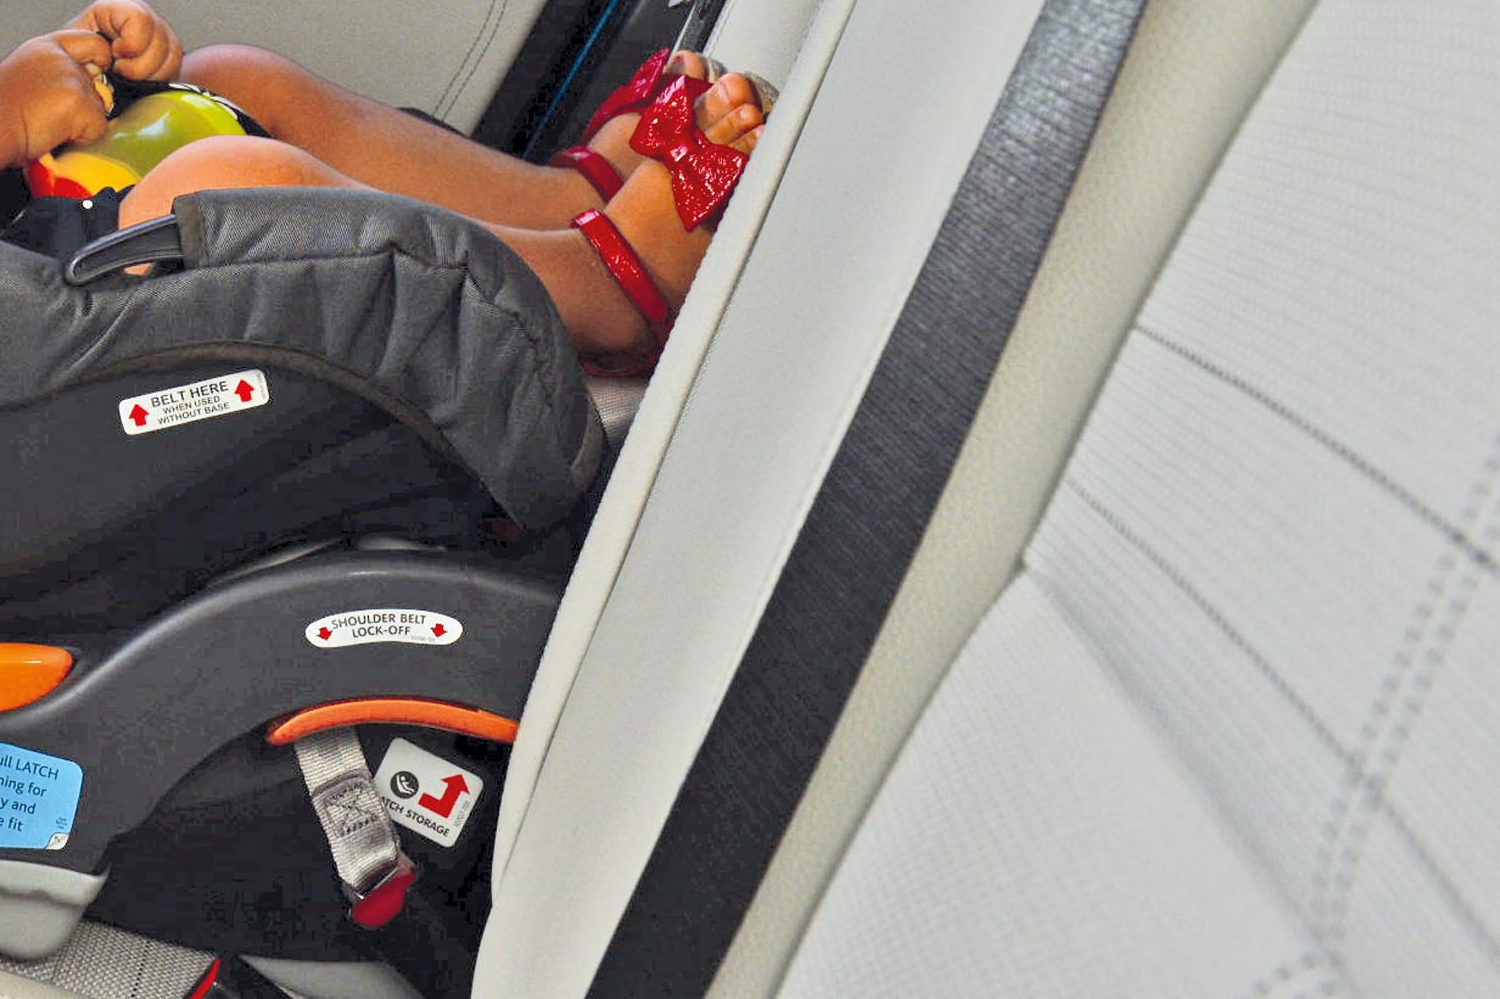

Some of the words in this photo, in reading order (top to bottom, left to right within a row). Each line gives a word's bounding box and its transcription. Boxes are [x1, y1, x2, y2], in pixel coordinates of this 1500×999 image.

[151, 390, 187, 408] BELT
[190, 381, 229, 399] HERE
[158, 410, 202, 425] WITHOUT
[204, 402, 231, 415] BASE
[163, 402, 193, 415] WHEN
[194, 396, 221, 408] USED
[331, 613, 396, 630] SHOULDER
[400, 613, 427, 624] BELT
[352, 625, 411, 638] LOCK-OFF
[16, 760, 60, 781] LATCH
[27, 782, 48, 798] for
[12, 801, 37, 815] and
[8, 818, 24, 832] fit
[406, 809, 450, 838] STORAGE
